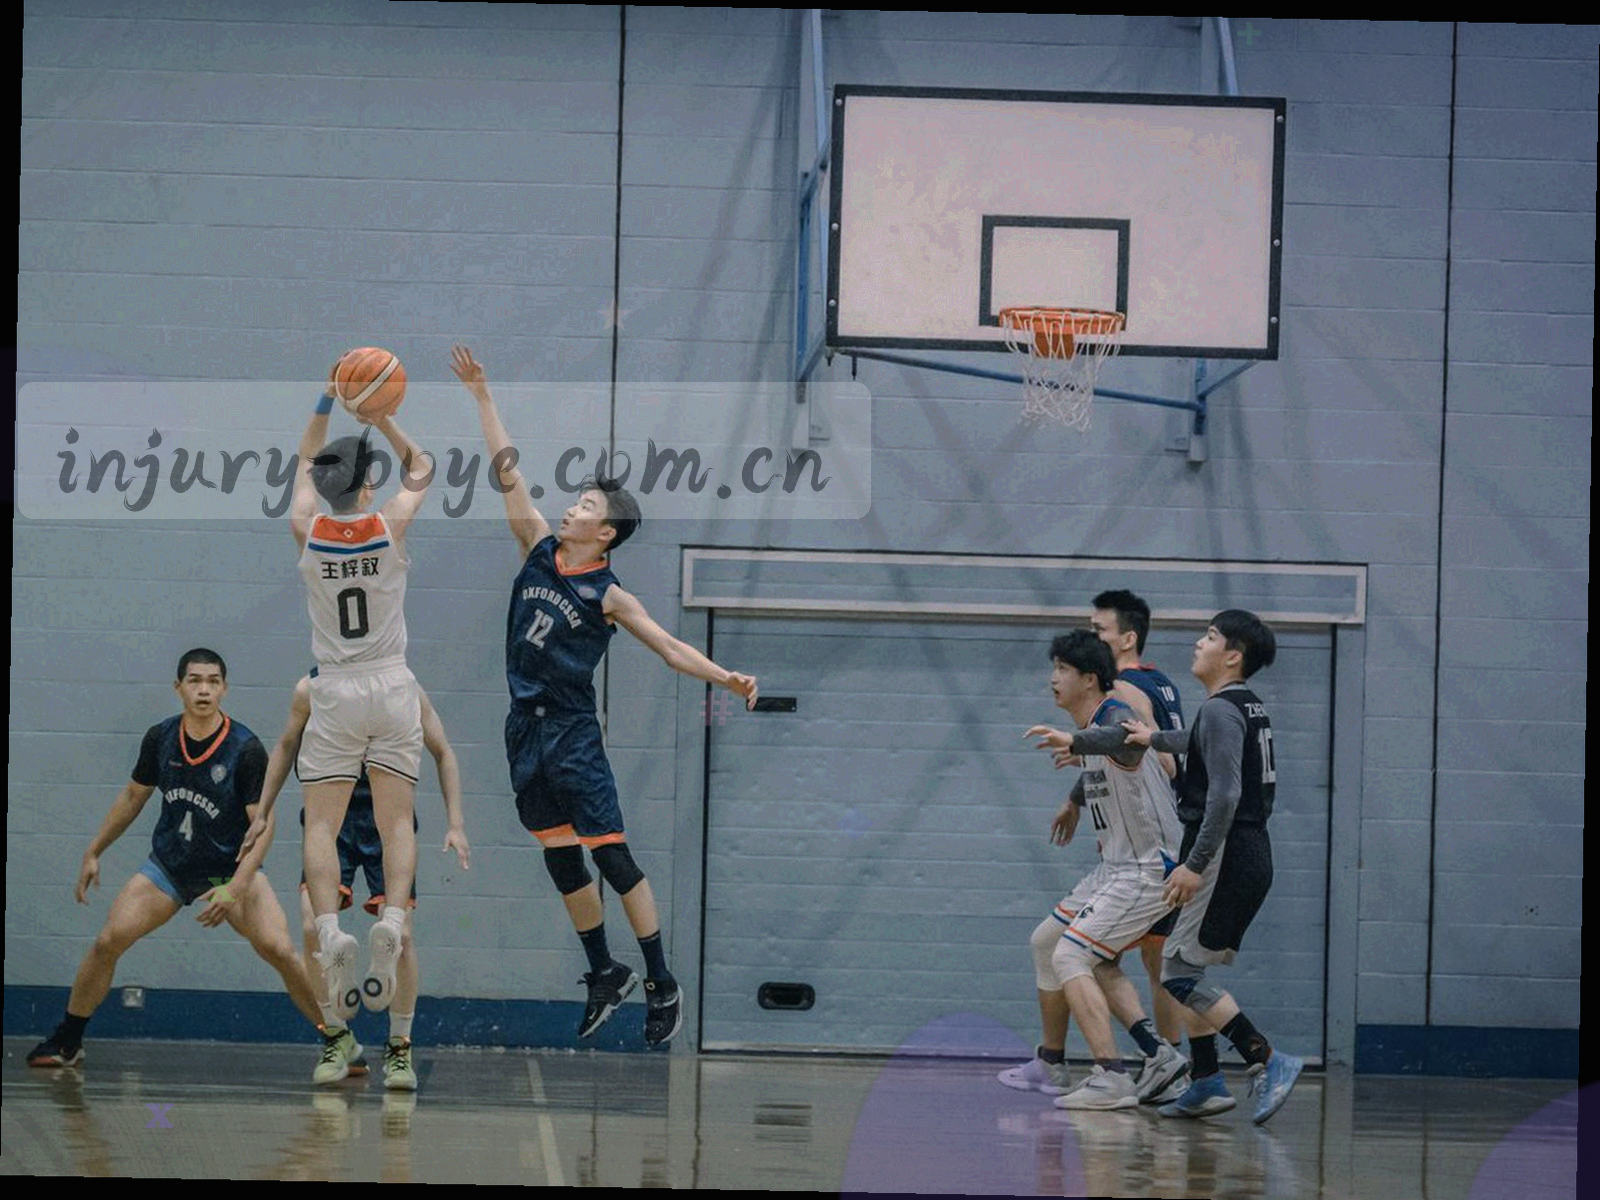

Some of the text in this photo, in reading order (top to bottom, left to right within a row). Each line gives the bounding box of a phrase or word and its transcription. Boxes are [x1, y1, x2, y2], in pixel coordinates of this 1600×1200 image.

[337, 586, 369, 639] 0
[525, 608, 555, 649] 12
[179, 810, 193, 841] 4
